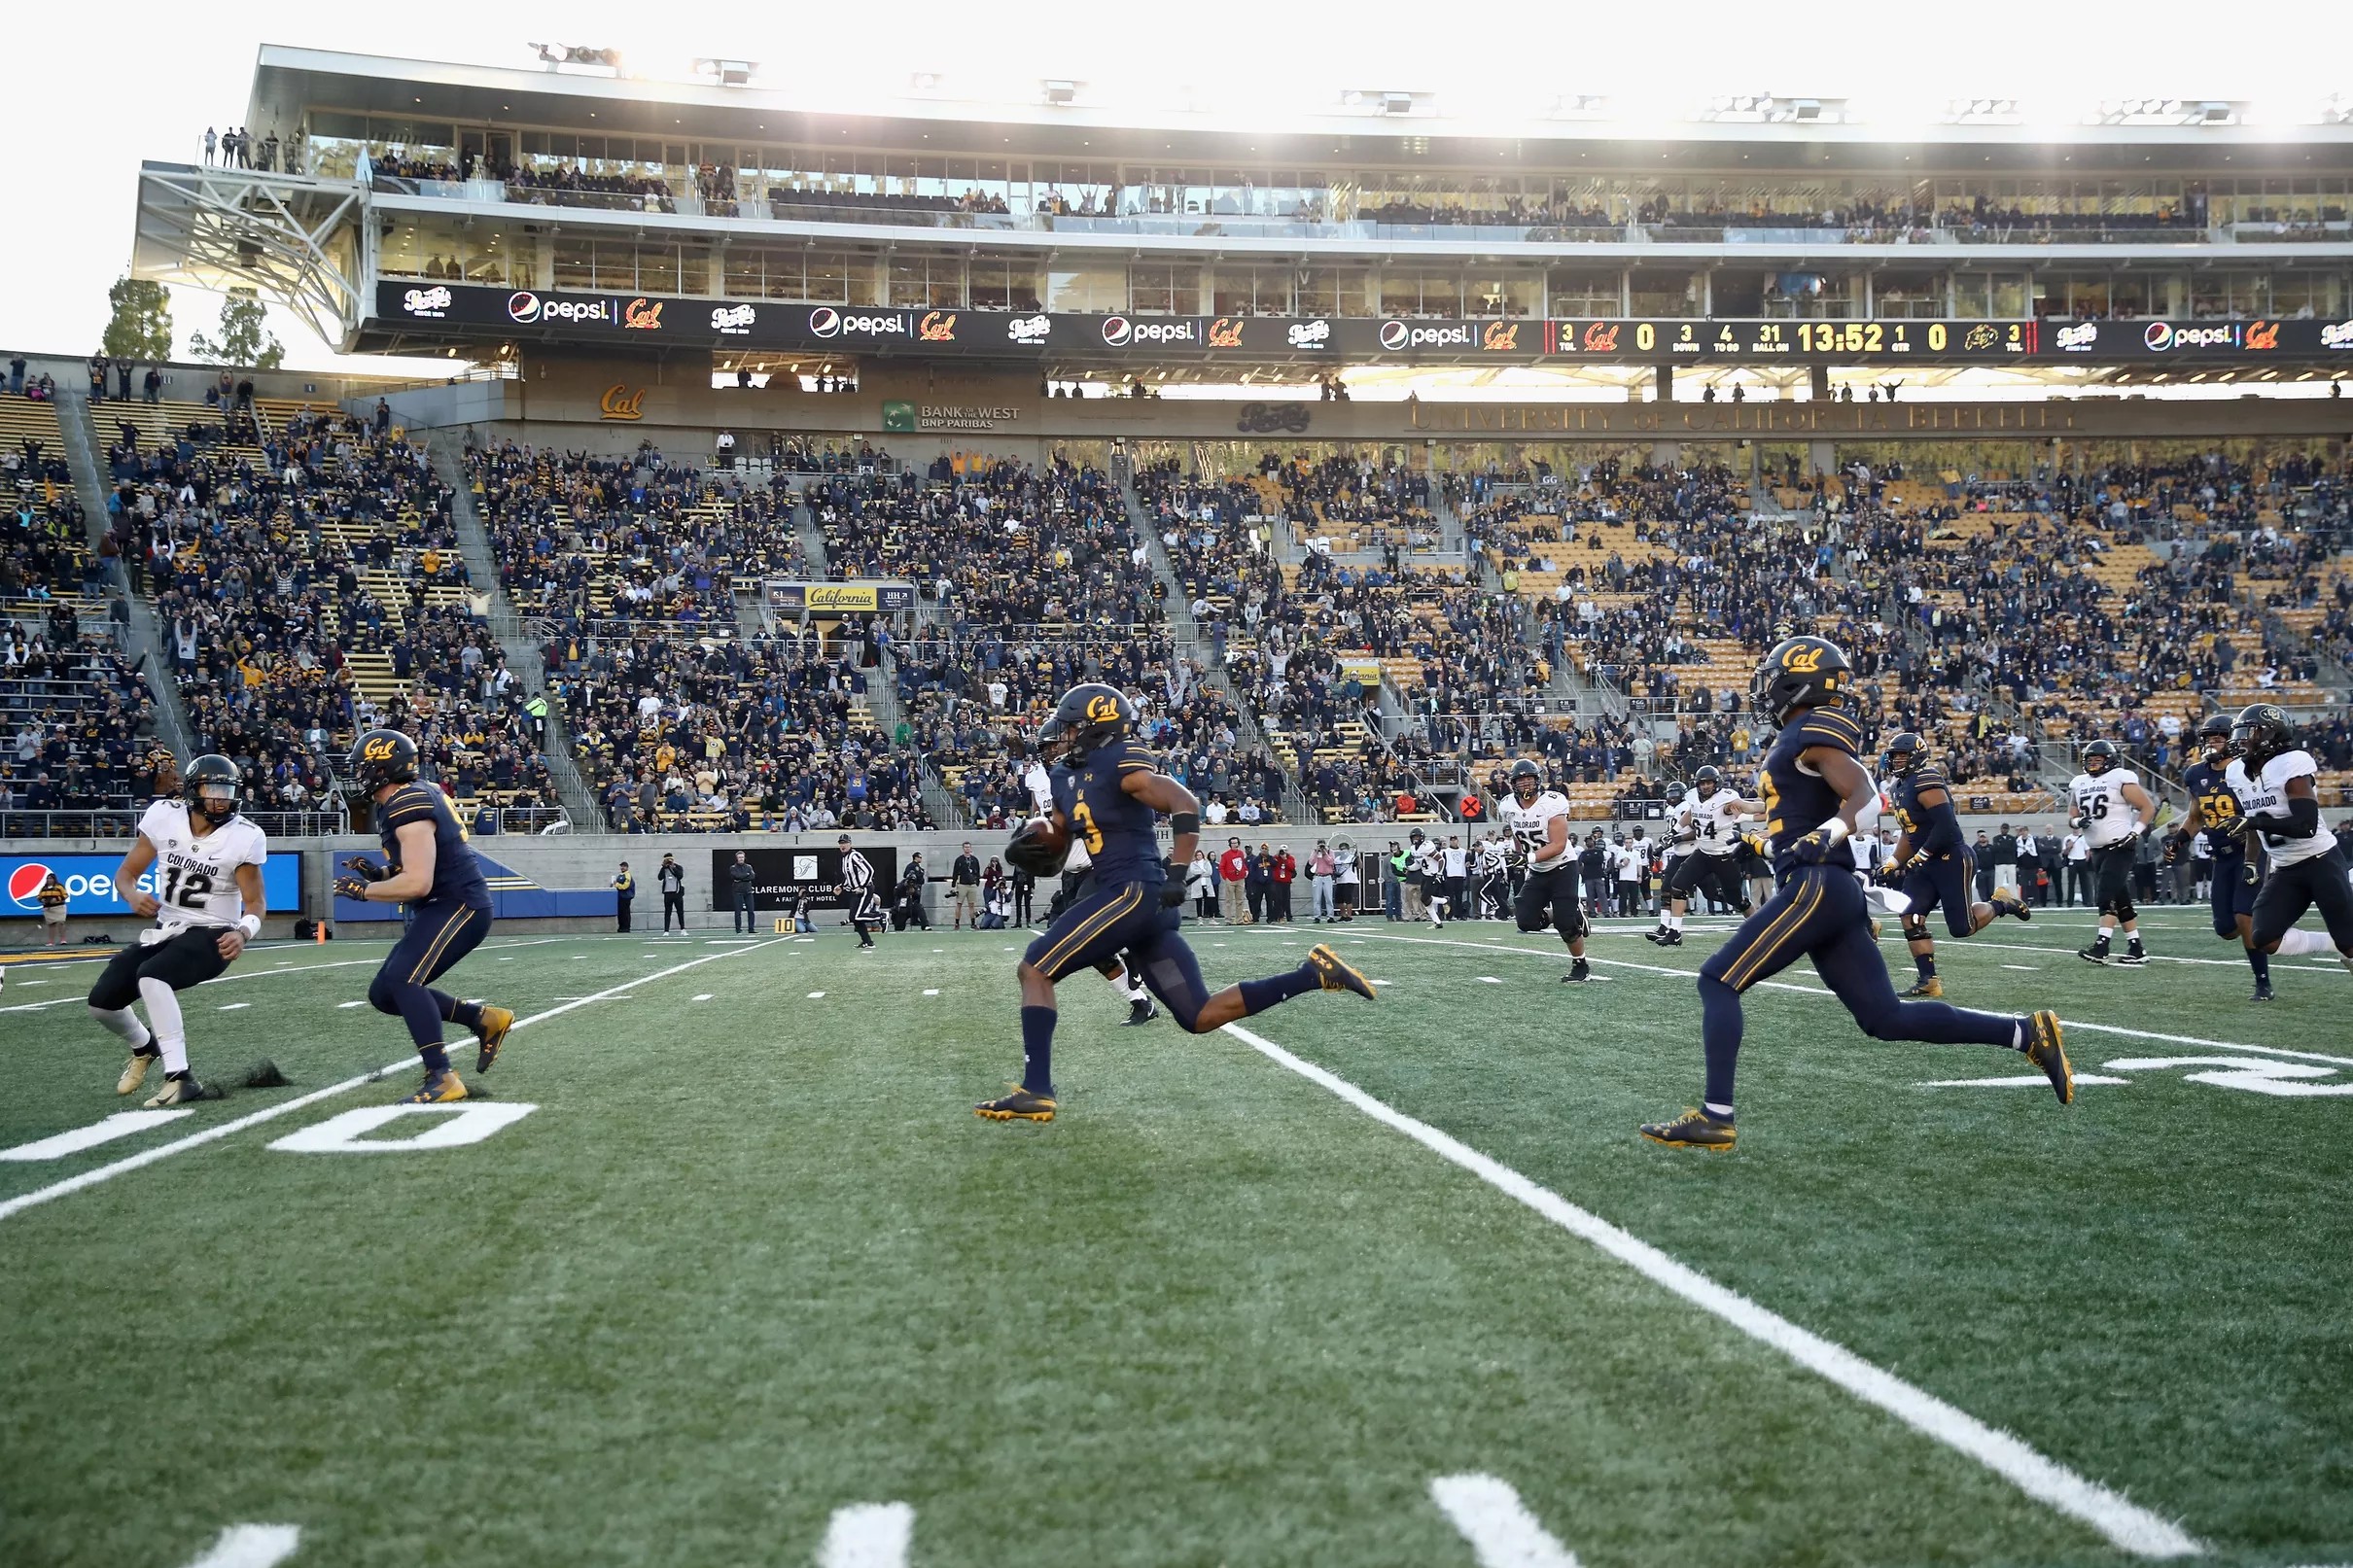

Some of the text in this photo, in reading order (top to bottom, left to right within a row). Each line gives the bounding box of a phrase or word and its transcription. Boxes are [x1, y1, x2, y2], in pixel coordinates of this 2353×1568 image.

[624, 297, 663, 330] Cal
[920, 310, 958, 340] Cal
[1209, 318, 1245, 347] Cal
[1483, 321, 1519, 351] Cal
[1562, 323, 1573, 340] 3
[1583, 322, 1620, 352] Cal
[1635, 323, 1655, 351] 0
[1680, 324, 1693, 341] 3
[1719, 324, 1733, 341] 4
[1759, 324, 1780, 341] 31
[1797, 323, 1883, 352] 13:52
[1894, 325, 1904, 341] 1
[1928, 323, 1947, 351] 0
[2008, 324, 2020, 341] 3
[2244, 319, 2280, 351] Cal
[1559, 341, 1577, 352] TOL
[1672, 342, 1700, 352] DOWN
[600, 384, 646, 420] Cal
[921, 405, 963, 418] BANK
[978, 407, 1020, 420] WEST
[921, 418, 994, 429] BNP PARIBAS
[1411, 404, 1616, 430] UNIVERSITY
[1634, 409, 1667, 430] OF
[1684, 406, 1887, 430] CALIFORIA
[809, 587, 873, 610] California
[1782, 644, 1825, 673] Cal
[1086, 695, 1120, 722] Cal
[364, 737, 397, 761] Cal
[2080, 785, 2107, 795] COLORADO
[2080, 794, 2109, 819] 56
[2198, 794, 2236, 829] 59
[2242, 795, 2277, 811] COLORADO
[1073, 801, 1105, 855] 3
[1692, 819, 1717, 839] 64
[1515, 830, 1547, 854] 65
[167, 853, 219, 877] COLORADO
[164, 866, 213, 909] 12
[778, 919, 792, 932] 10
